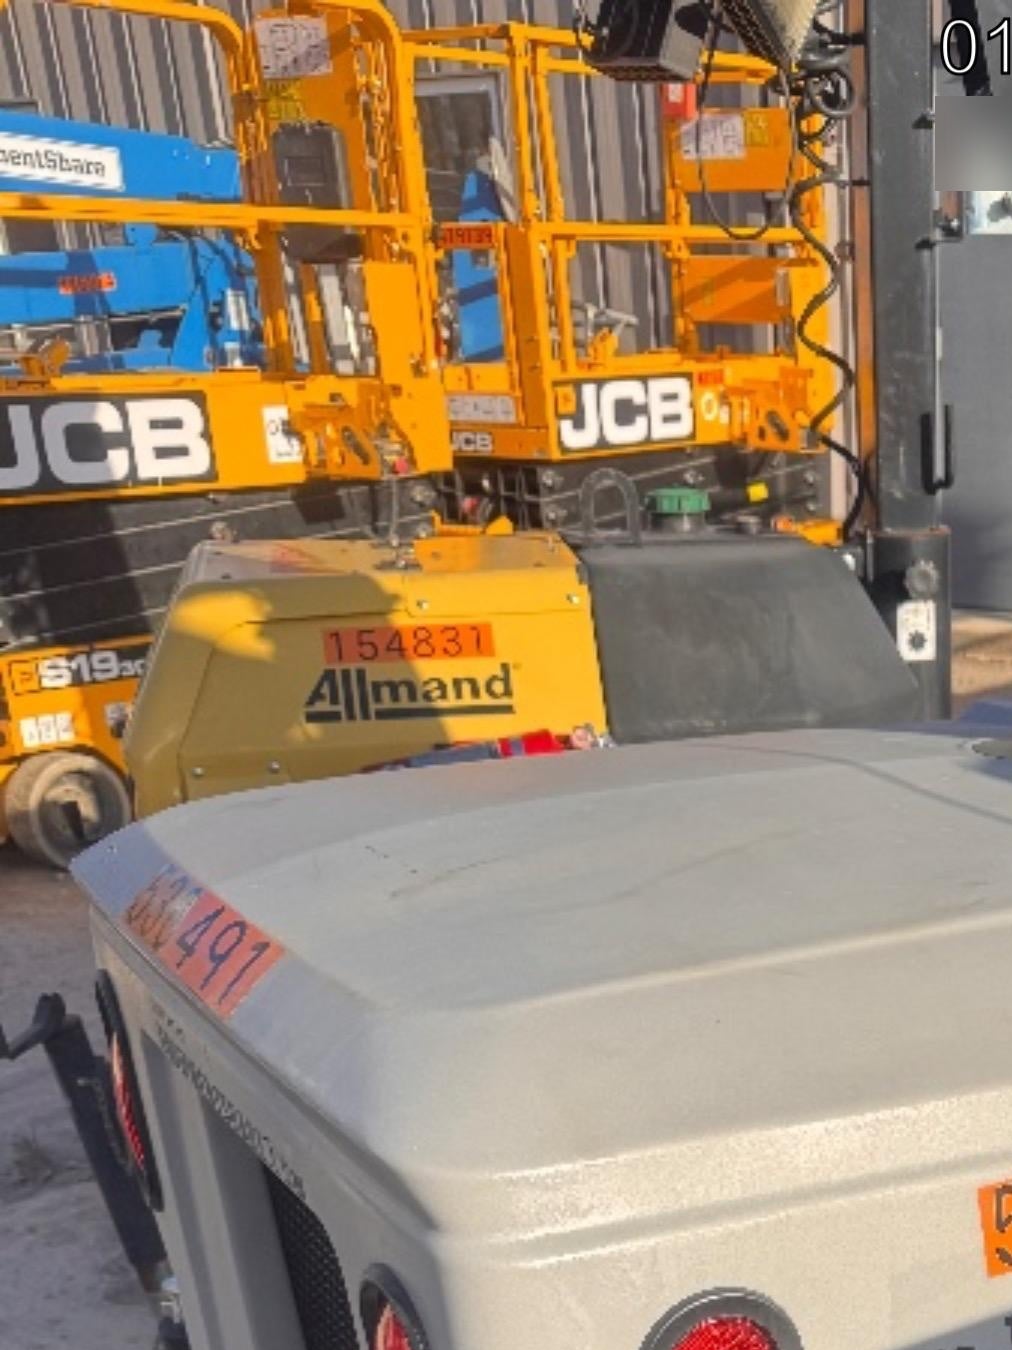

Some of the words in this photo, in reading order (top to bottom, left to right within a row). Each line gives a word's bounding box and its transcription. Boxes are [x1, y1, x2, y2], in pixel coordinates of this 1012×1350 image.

[0, 398, 211, 490] JCB
[559, 378, 694, 448] JCB
[329, 625, 484, 663] 154831
[304, 663, 514, 722] Allmand
